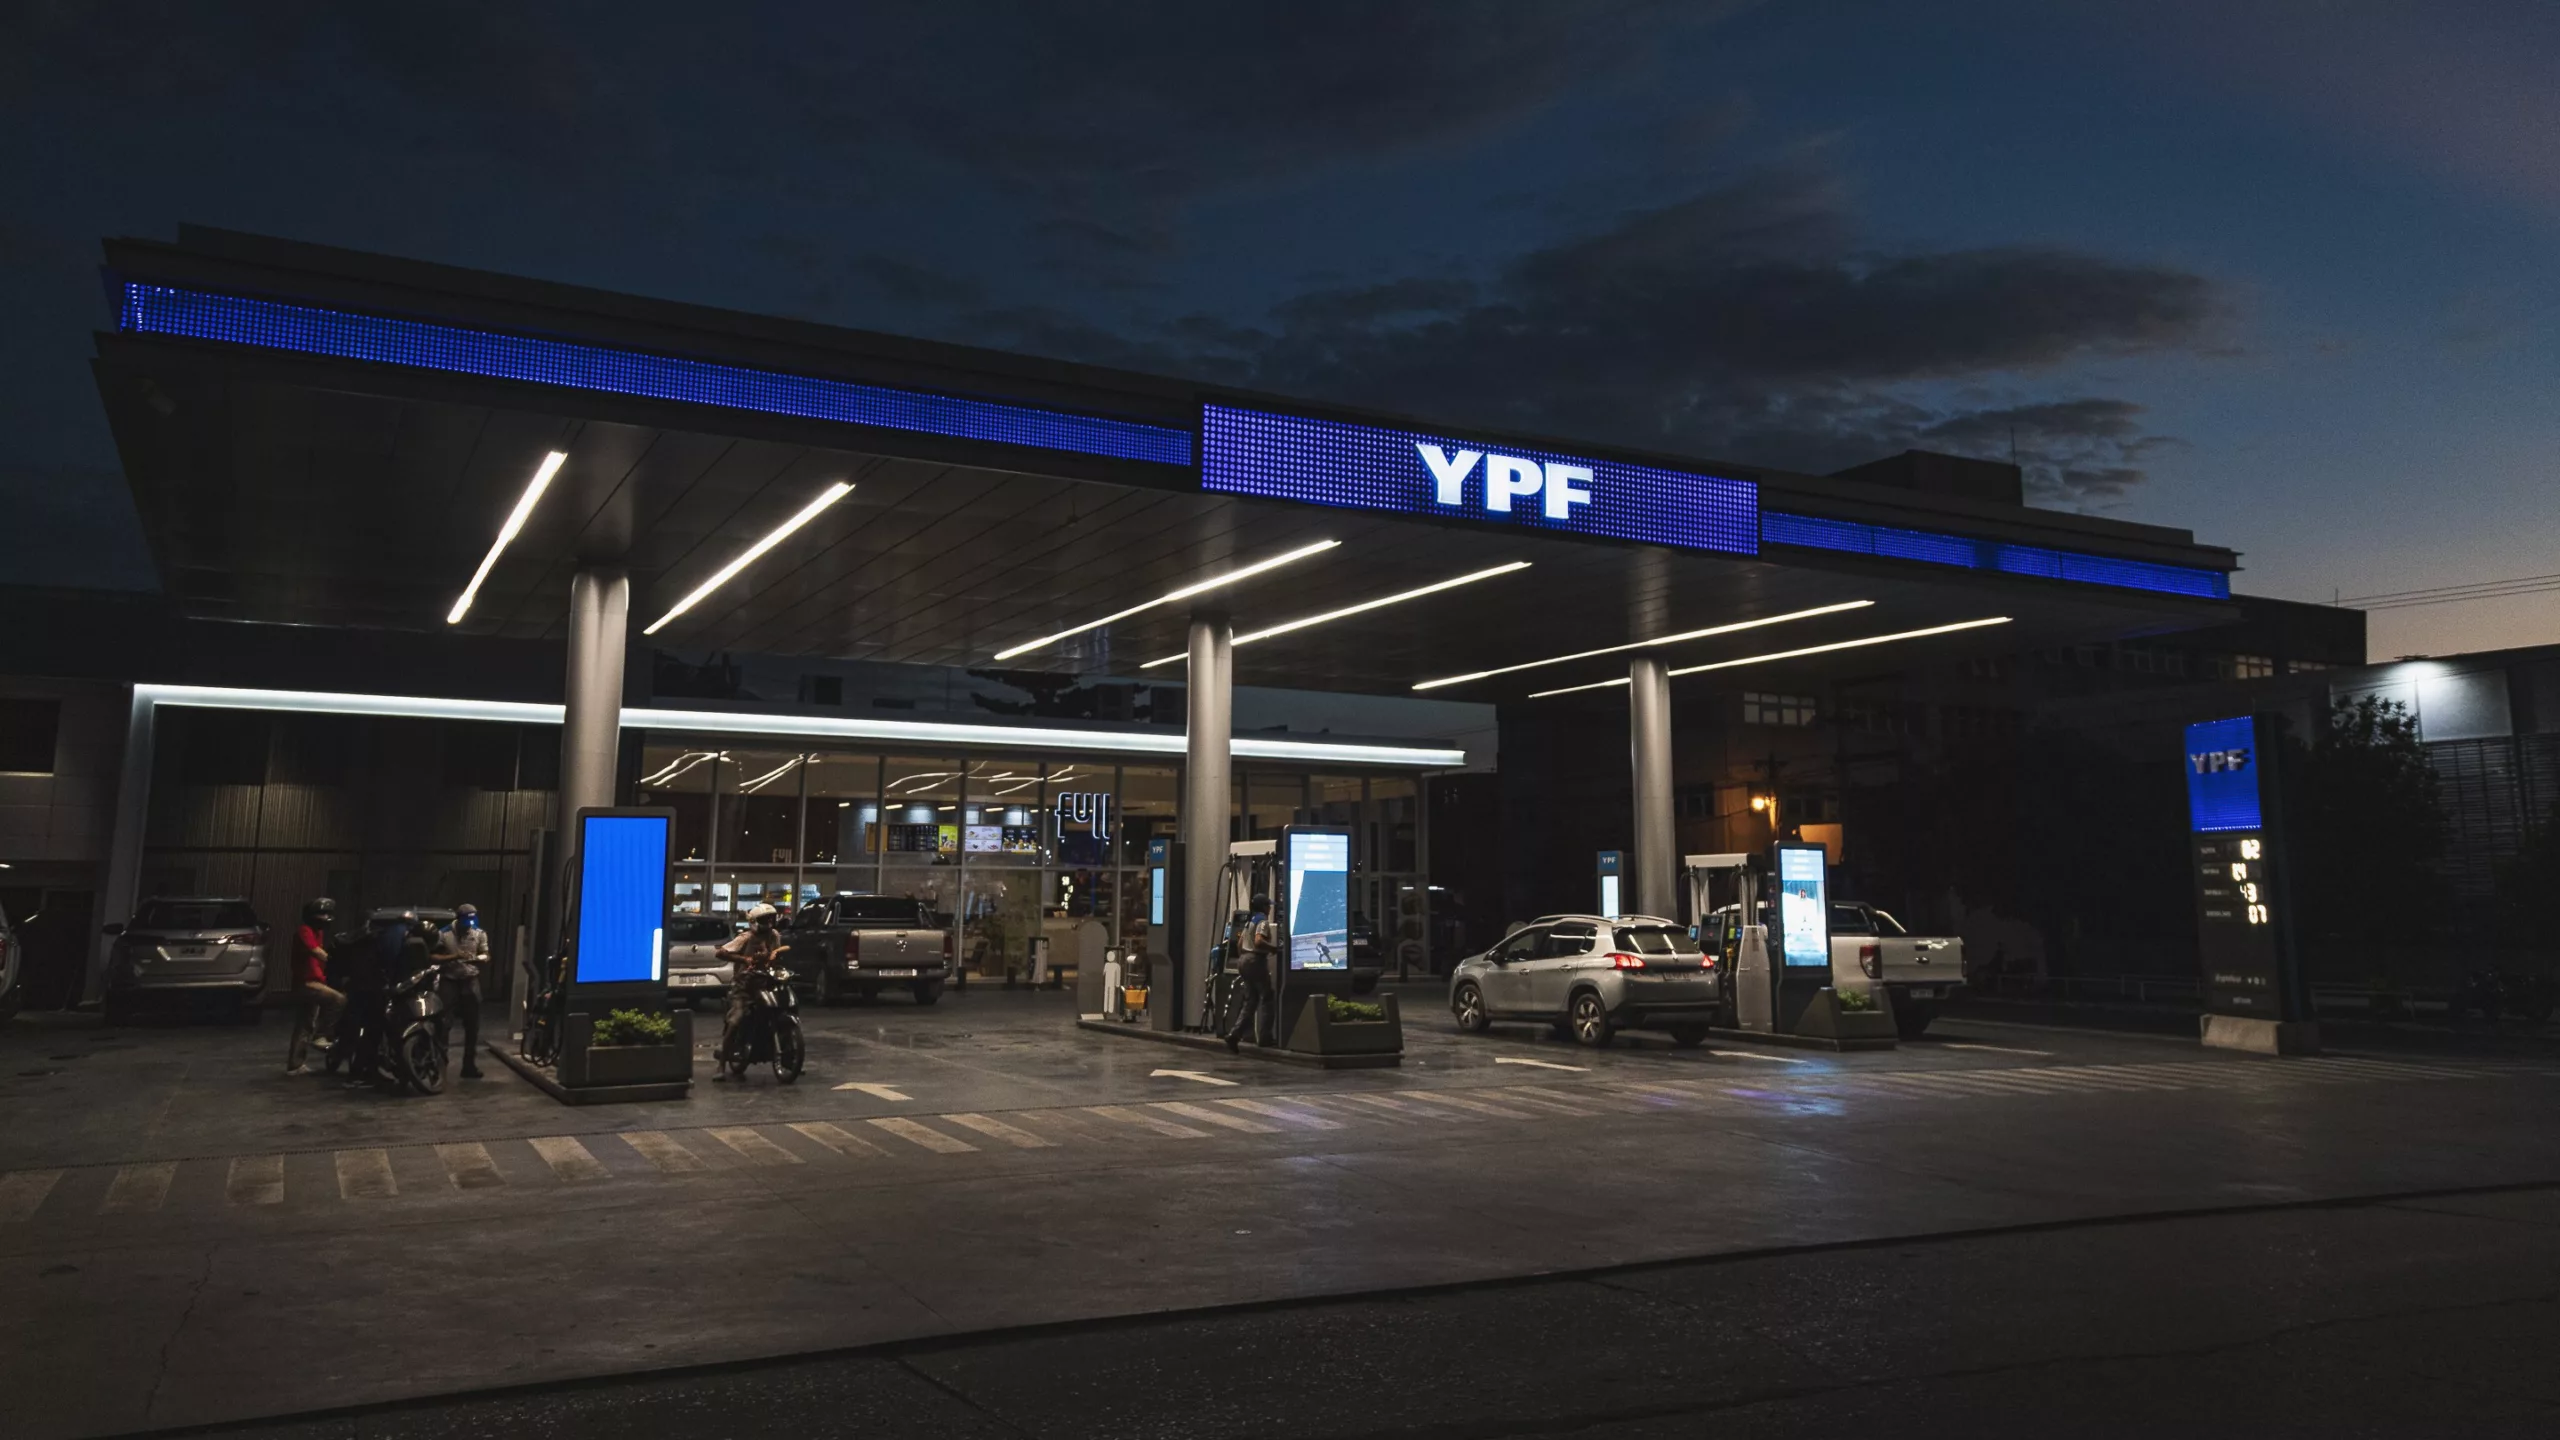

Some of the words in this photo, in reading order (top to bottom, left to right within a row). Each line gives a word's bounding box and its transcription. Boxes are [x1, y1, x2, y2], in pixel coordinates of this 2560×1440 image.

[1415, 443, 1594, 520] YPF
[2189, 749, 2246, 774] YPF
[1054, 792, 1111, 839] full
[1152, 845, 1164, 854] YPF
[1602, 856, 1616, 864] YPF
